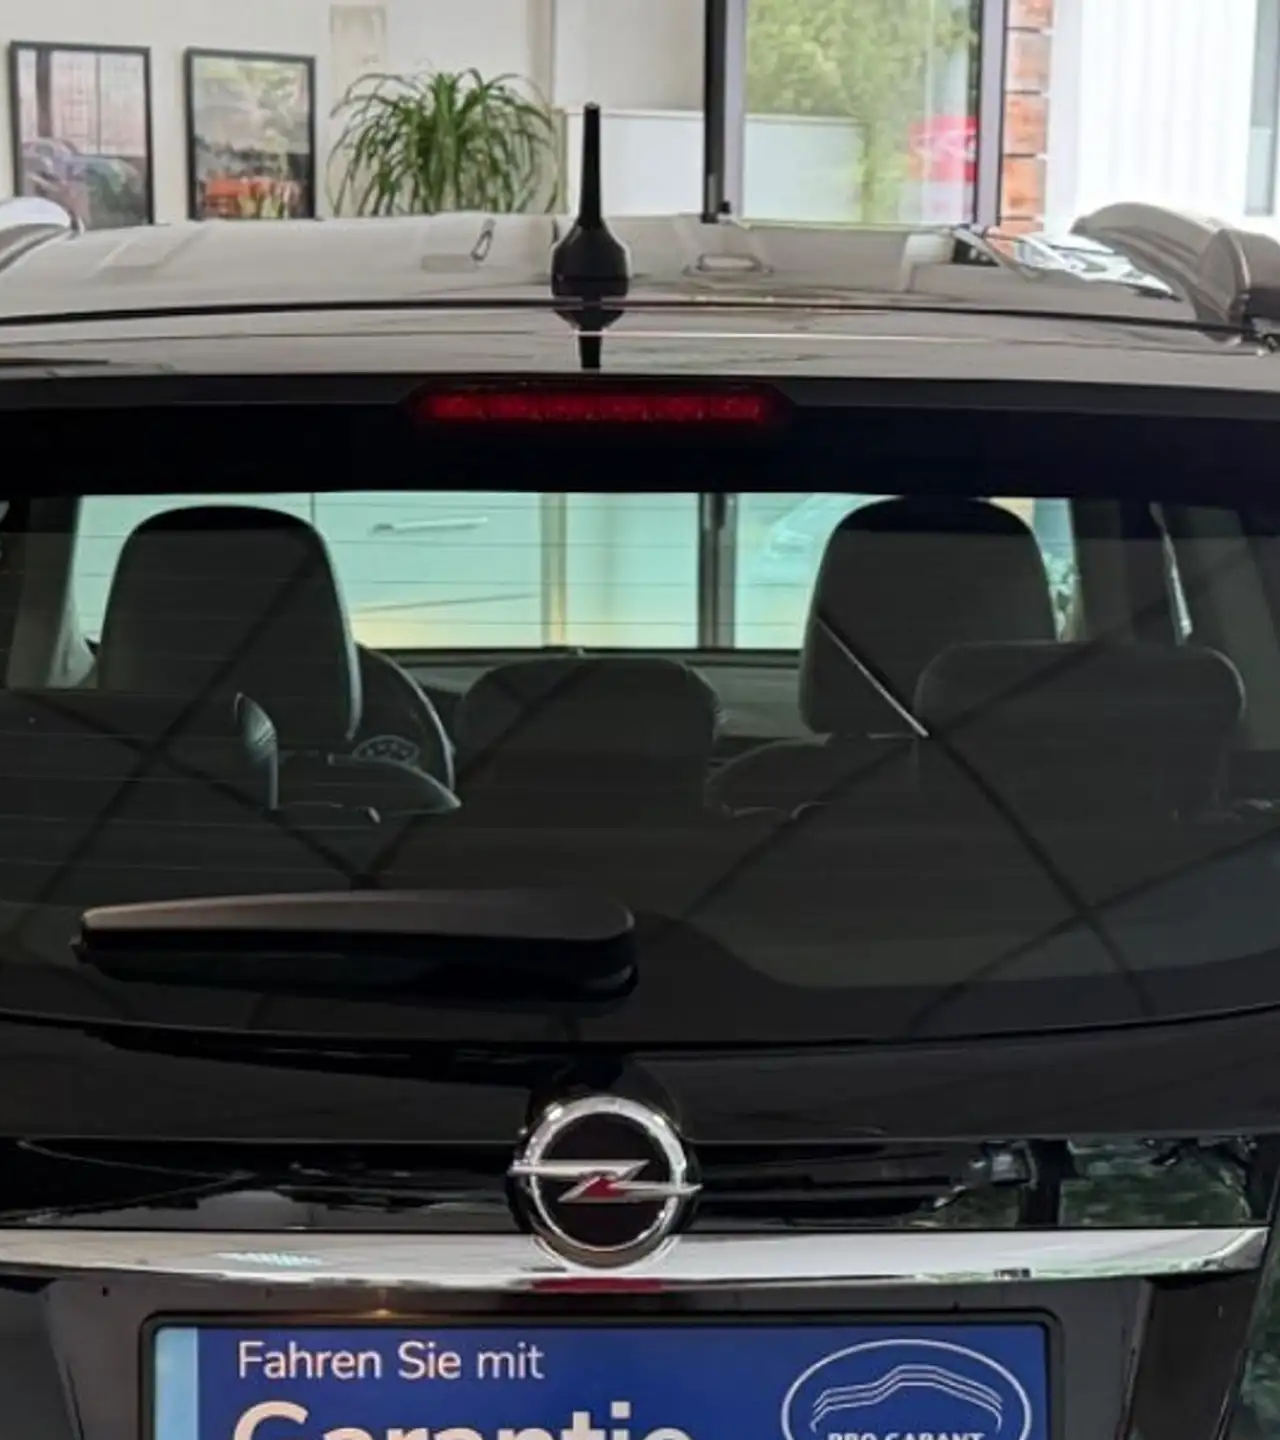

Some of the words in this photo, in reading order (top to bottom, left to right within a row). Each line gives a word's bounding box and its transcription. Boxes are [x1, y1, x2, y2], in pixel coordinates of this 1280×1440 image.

[239, 1340, 383, 1380] Fahren
[397, 1340, 463, 1380] Sie
[477, 1341, 545, 1379] mit
